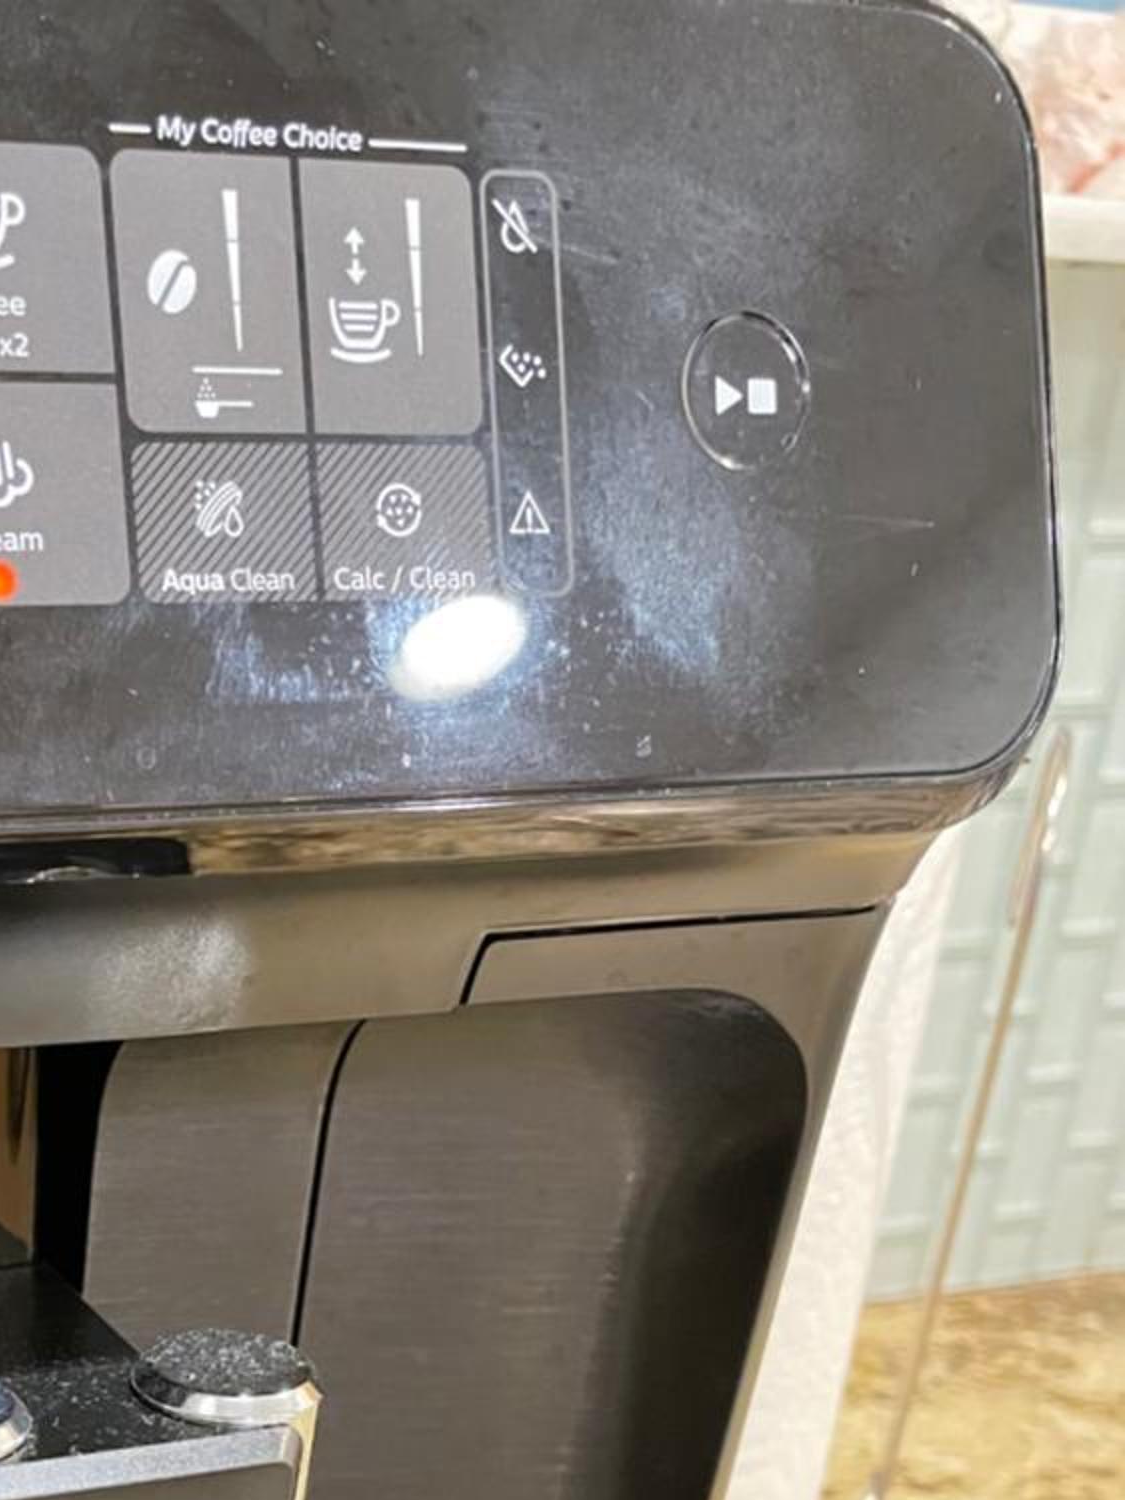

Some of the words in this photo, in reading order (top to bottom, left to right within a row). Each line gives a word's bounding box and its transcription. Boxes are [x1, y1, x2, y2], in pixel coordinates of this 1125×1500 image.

[157, 115, 196, 147] My
[200, 117, 277, 149] Coffee
[283, 122, 363, 152] Choice
[161, 568, 225, 595] Aqua
[229, 567, 296, 592] Clean
[332, 566, 387, 592] Calc
[409, 565, 476, 590] Clean
